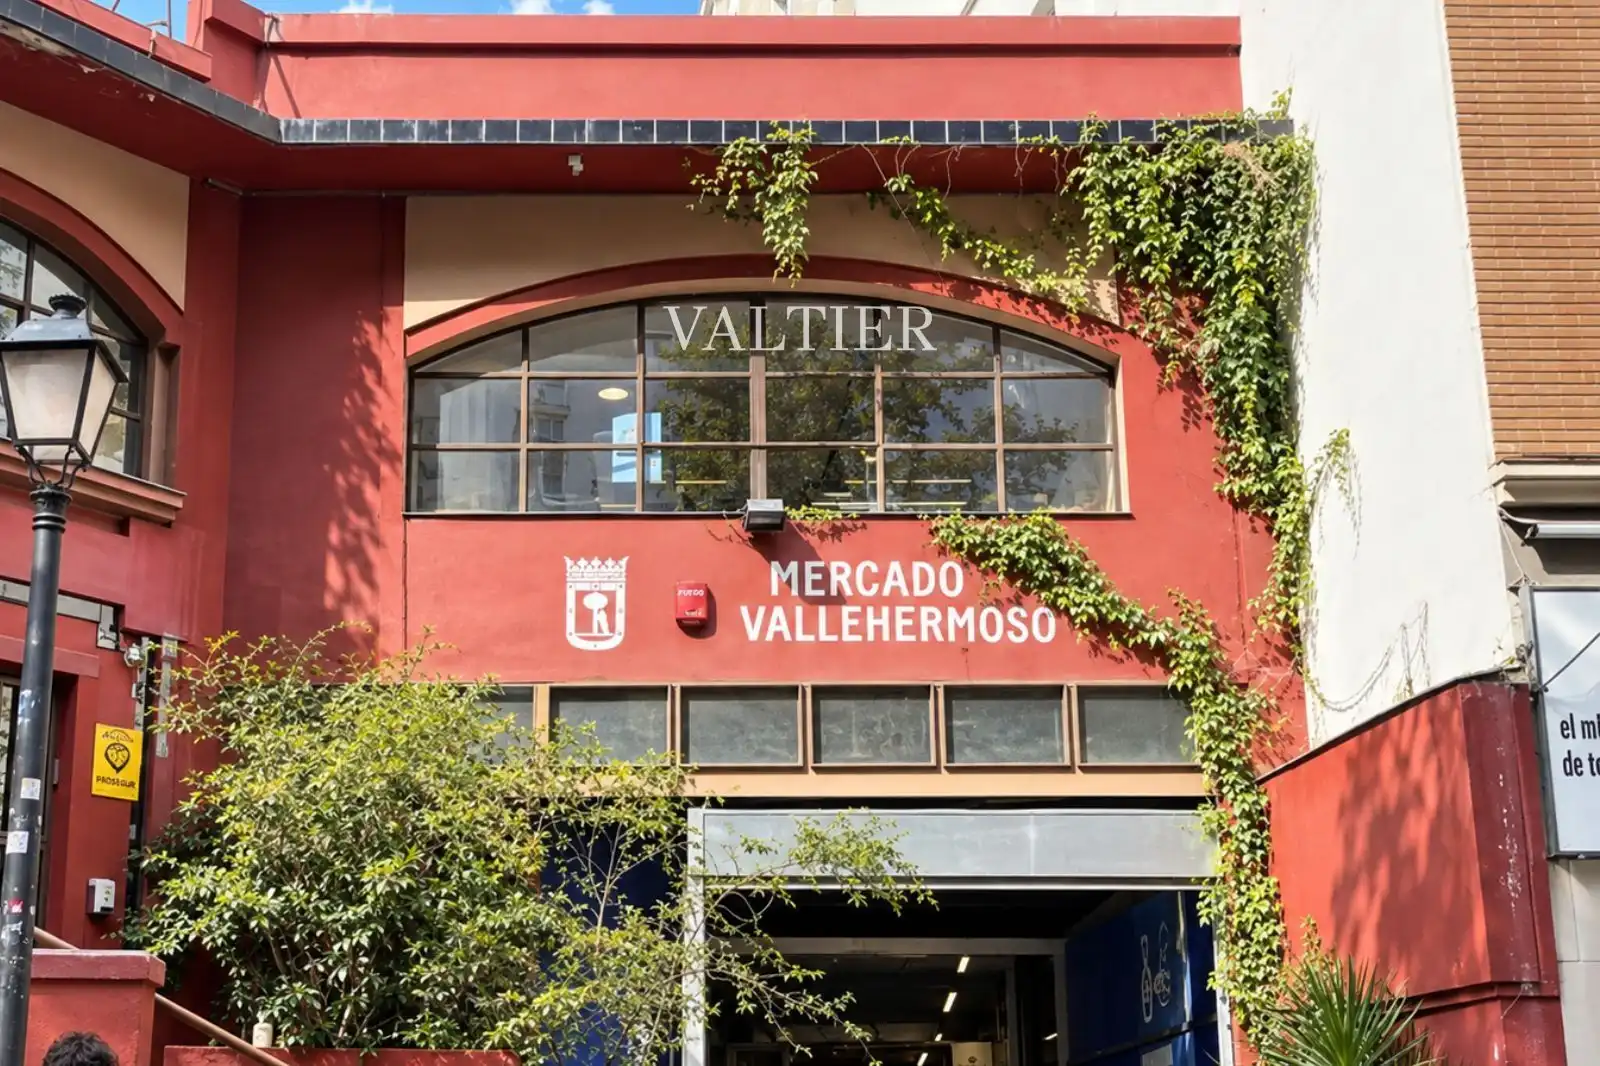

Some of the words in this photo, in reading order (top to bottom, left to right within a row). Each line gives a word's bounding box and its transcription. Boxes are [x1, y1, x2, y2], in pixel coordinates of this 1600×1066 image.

[663, 305, 938, 351] VALTIER
[770, 560, 964, 597] MERCADO
[740, 605, 1057, 643] VALLEHERMOSO
[1560, 712, 1576, 739] el
[1563, 749, 1584, 776] de
